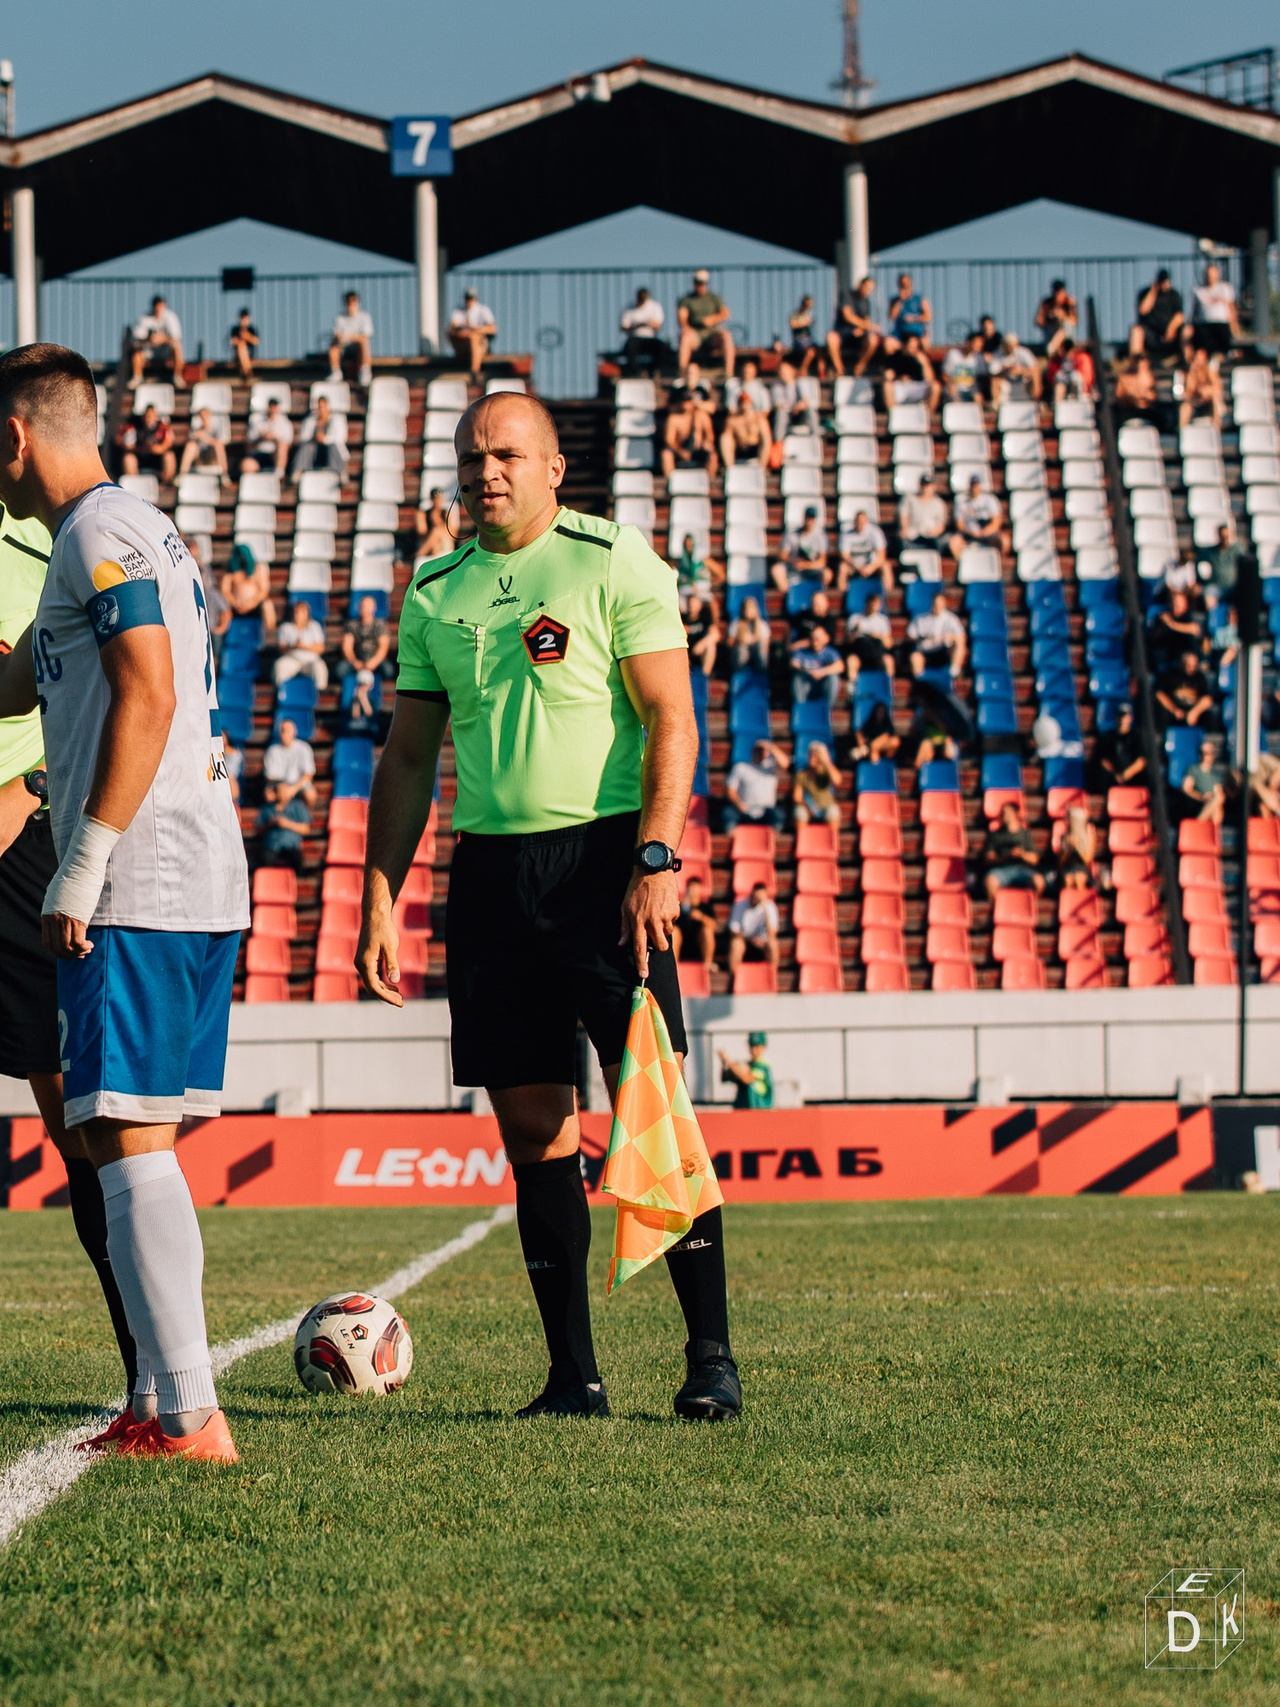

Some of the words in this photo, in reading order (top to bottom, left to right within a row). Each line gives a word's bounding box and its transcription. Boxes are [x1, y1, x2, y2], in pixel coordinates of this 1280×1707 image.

[407, 121, 437, 167] 7
[124, 560, 147, 573] БАМ
[538, 633, 557, 650] 2
[838, 1147, 883, 1177] Б
